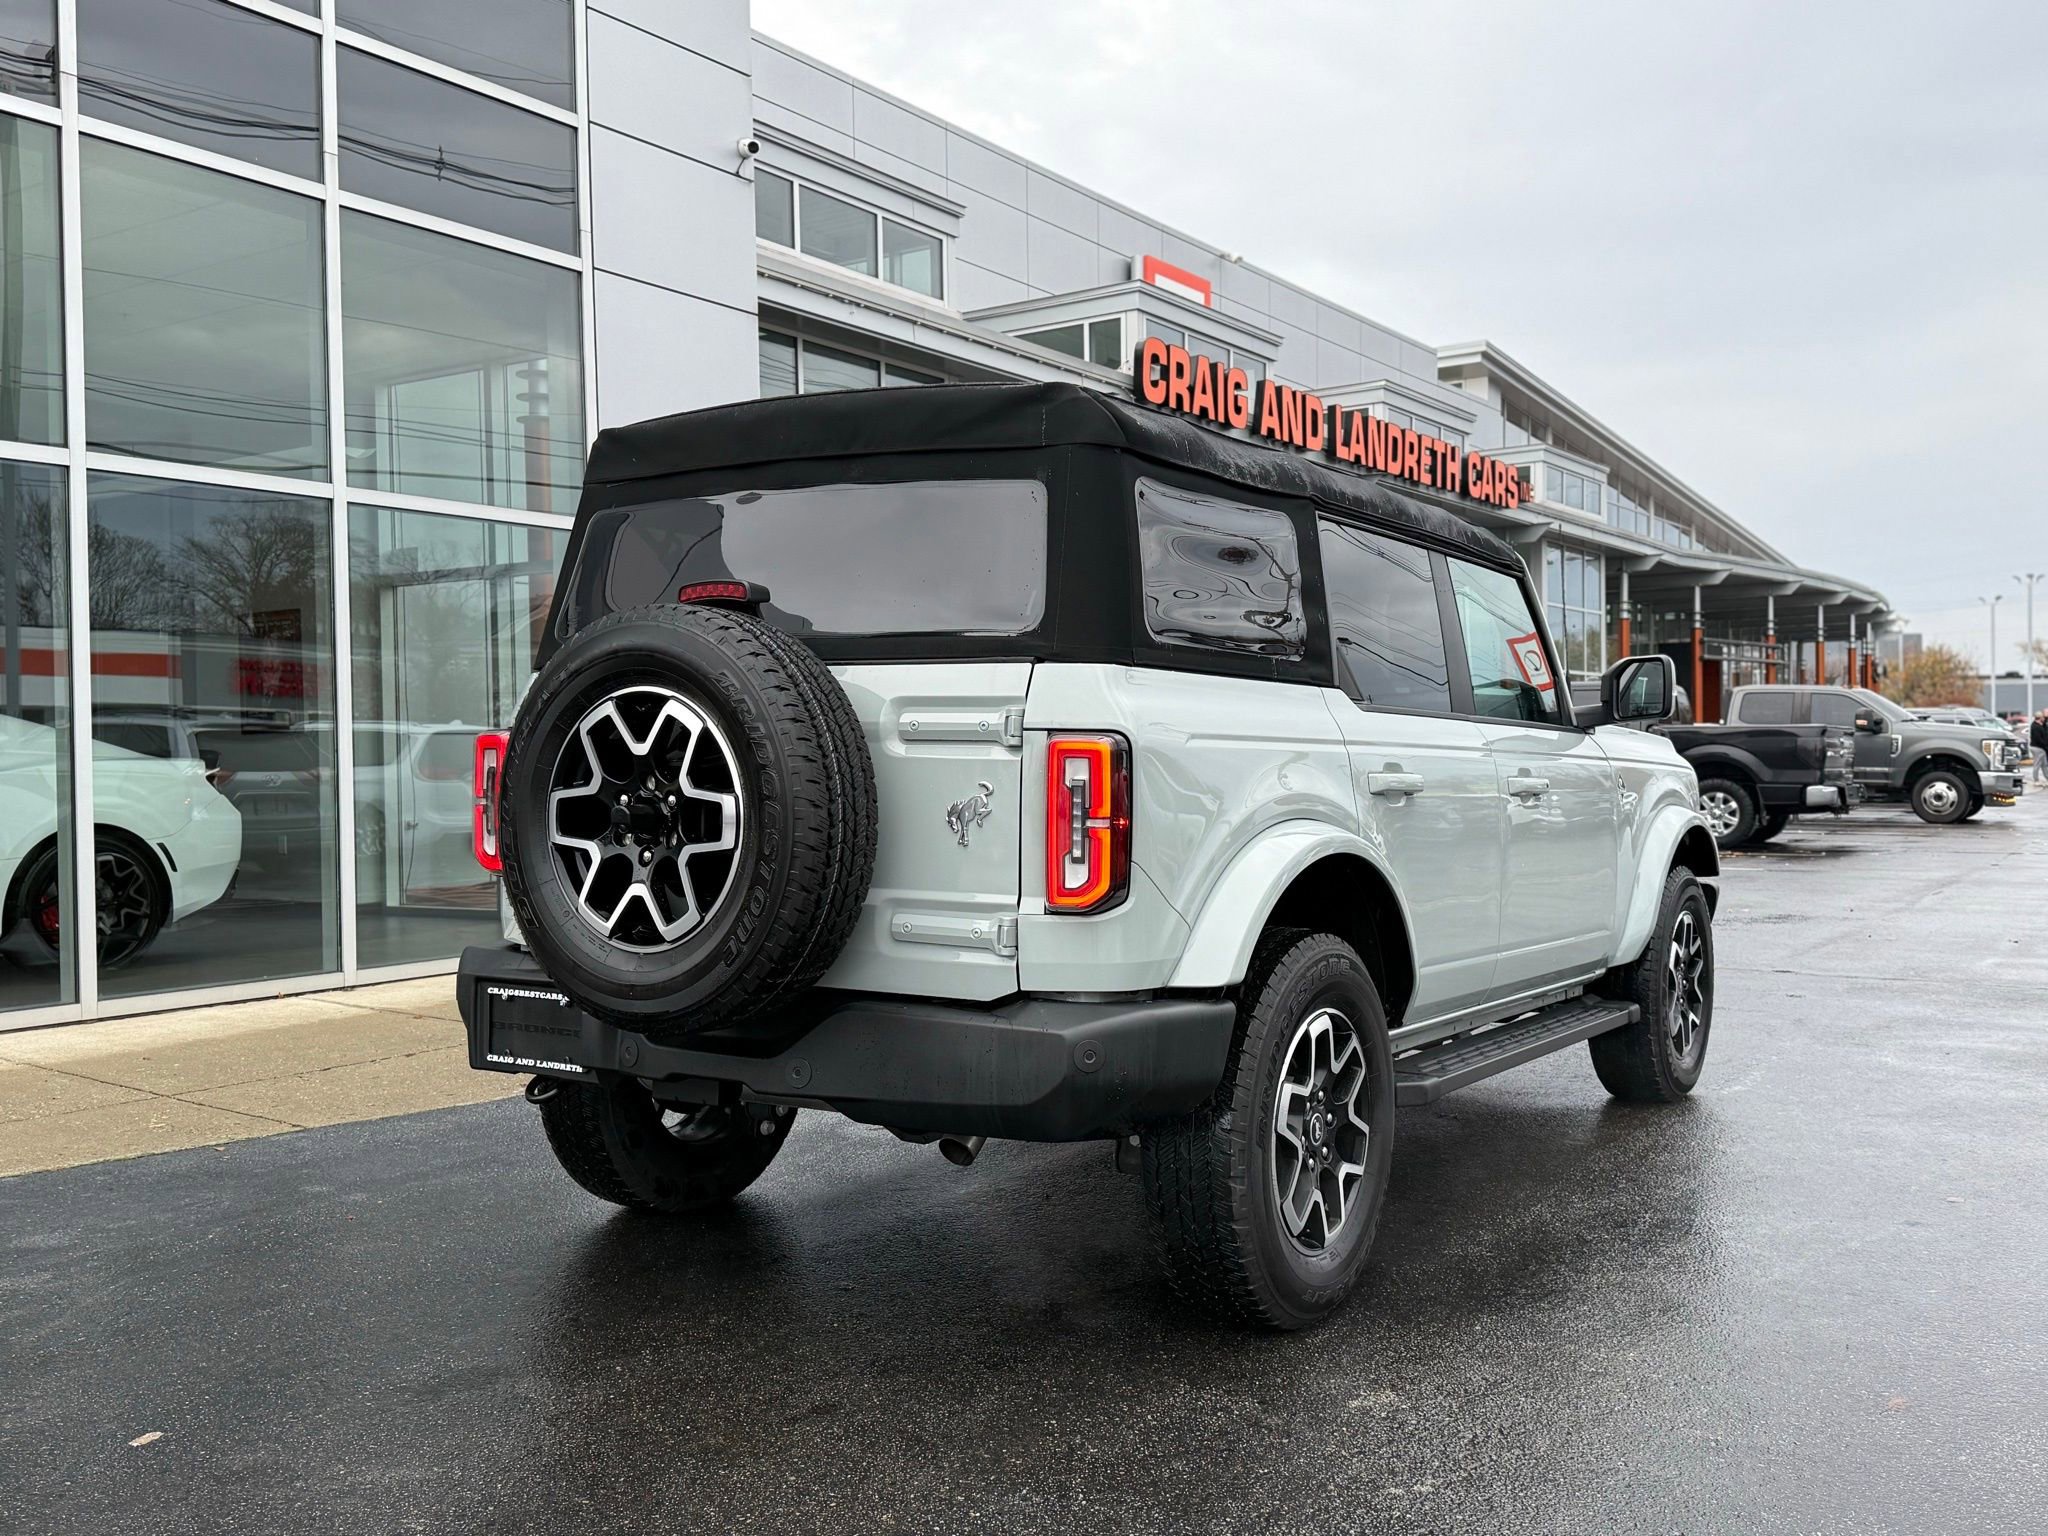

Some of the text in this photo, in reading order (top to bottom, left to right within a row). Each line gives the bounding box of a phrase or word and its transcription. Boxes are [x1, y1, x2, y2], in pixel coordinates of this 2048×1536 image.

[1141, 336, 1248, 429] CRAIG
[1260, 380, 1324, 451] AND
[1335, 404, 1461, 493] LANDRETH
[1467, 451, 1519, 508] CARS
[486, 1054, 583, 1073] CRAIG AND LANDRETH
